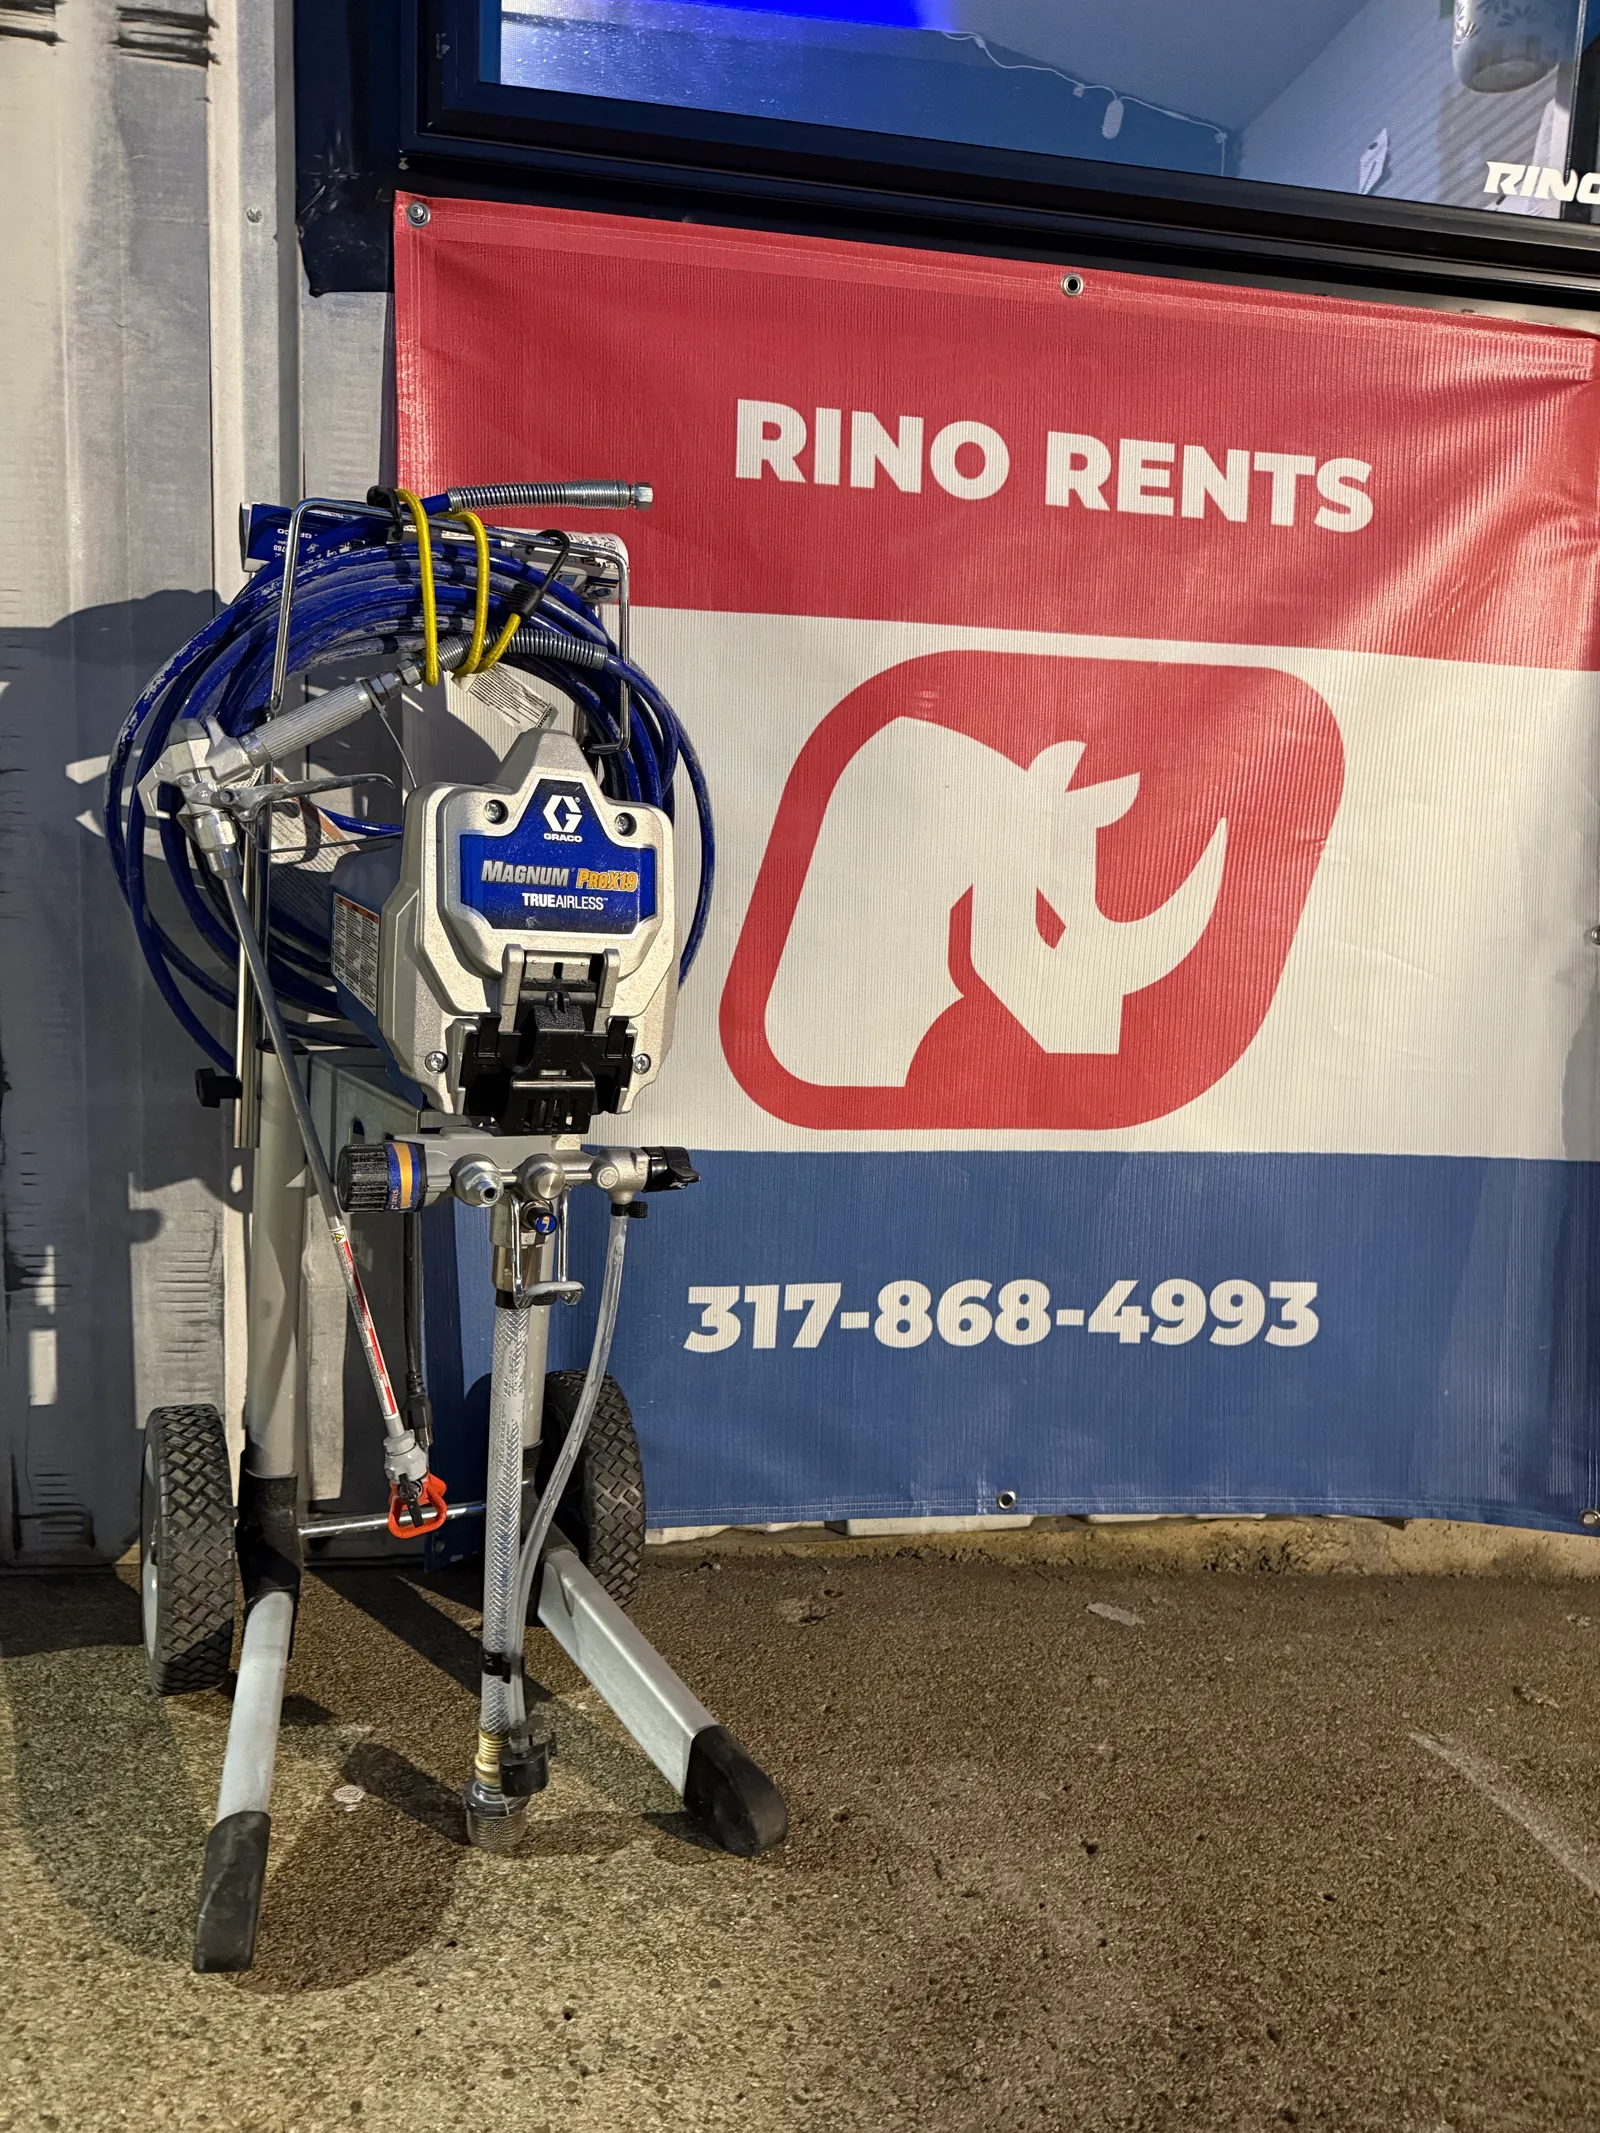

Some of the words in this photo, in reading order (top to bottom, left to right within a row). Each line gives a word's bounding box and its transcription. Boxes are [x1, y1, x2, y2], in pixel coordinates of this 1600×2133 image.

[736, 398, 1010, 501] RINO
[1045, 431, 1374, 533] RENTS
[543, 833, 583, 843] GRACO
[481, 860, 570, 887] MAGNUM
[683, 1279, 1319, 1353] 317-868-4993
